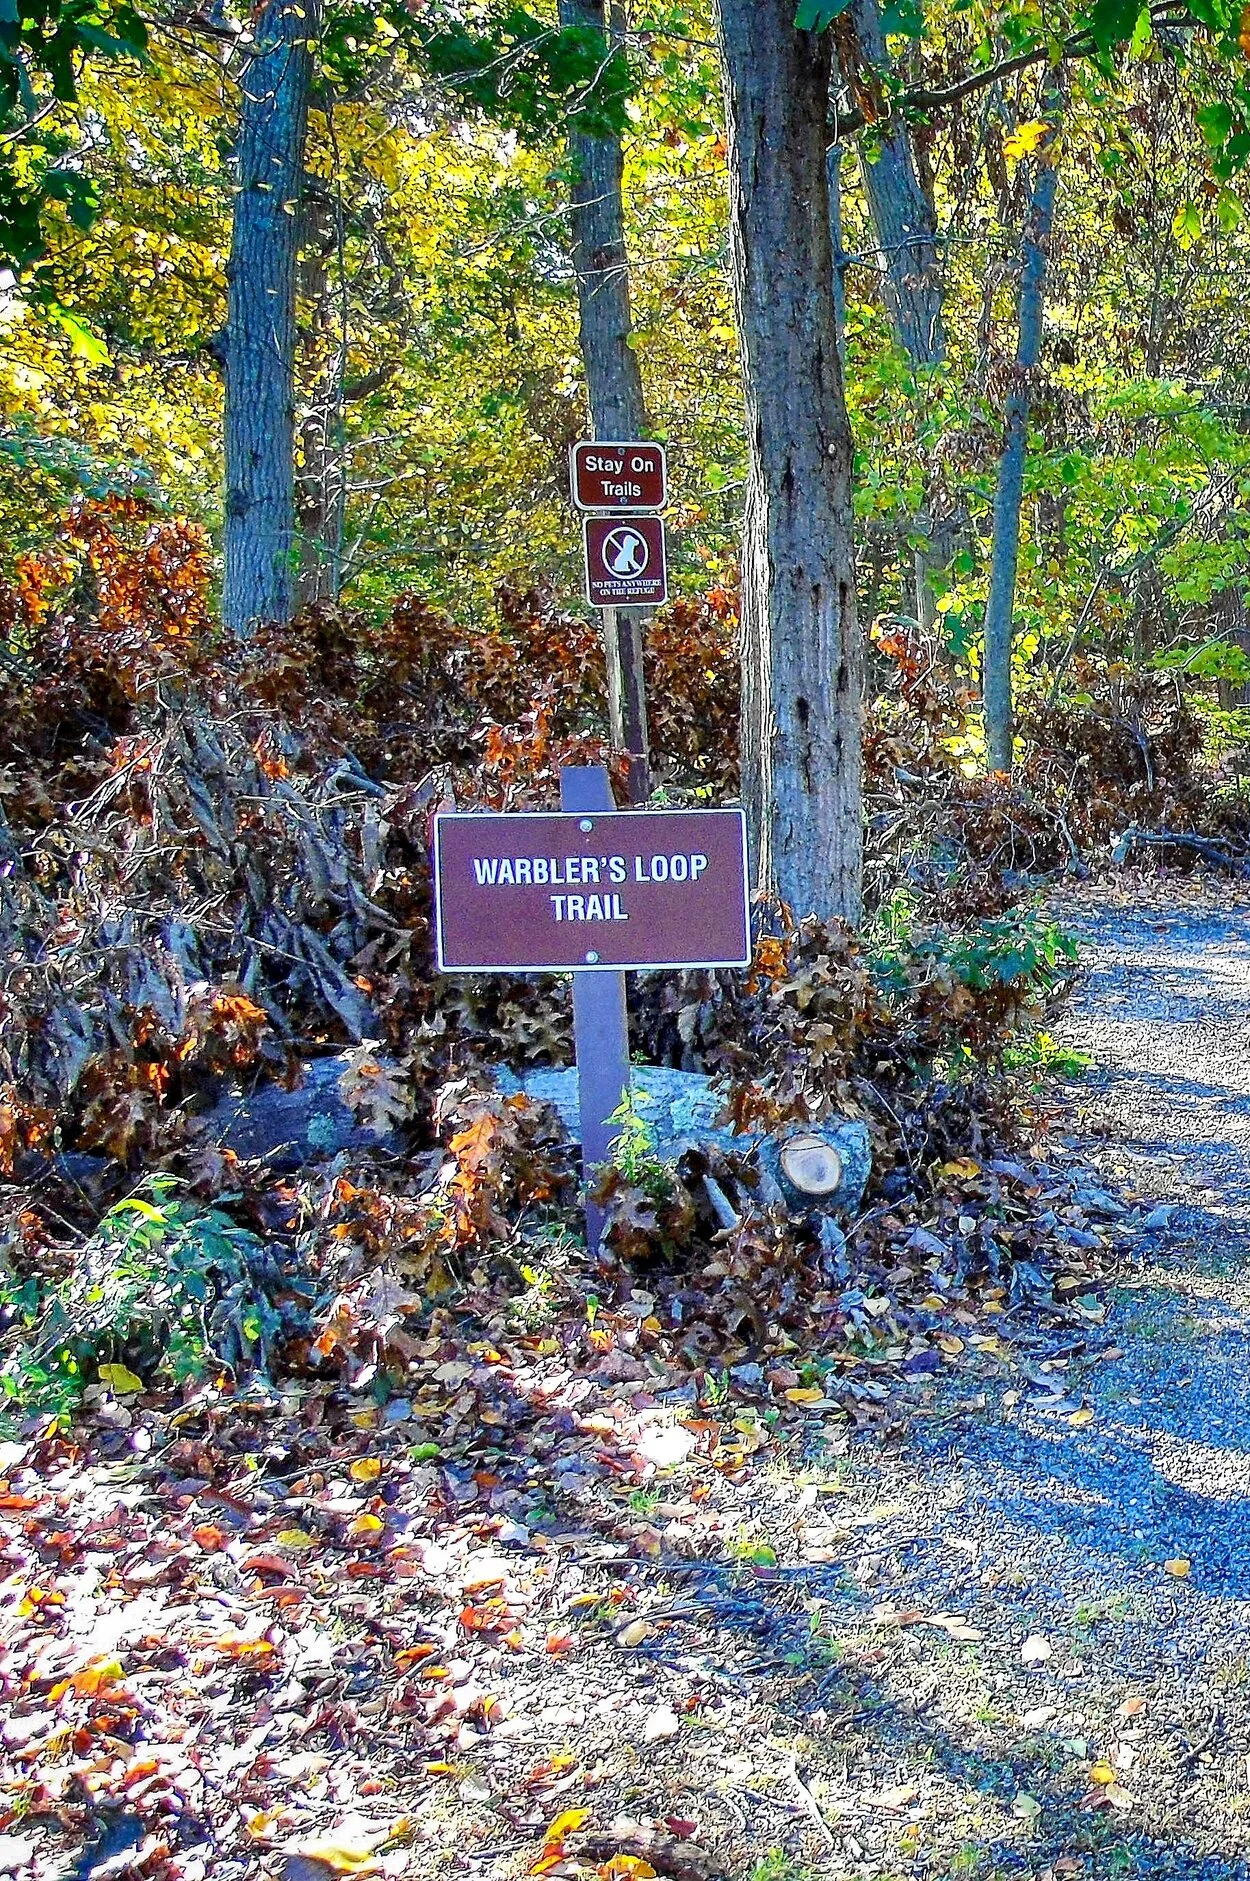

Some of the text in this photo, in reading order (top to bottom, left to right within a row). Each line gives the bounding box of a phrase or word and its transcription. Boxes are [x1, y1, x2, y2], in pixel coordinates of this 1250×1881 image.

[586, 456, 654, 475] Stay On
[601, 481, 641, 496] Trails
[592, 579, 662, 588] NO PETS ANYWHERE
[474, 854, 708, 885] WARBLER'S LOOP
[550, 895, 629, 921] TRAIL
